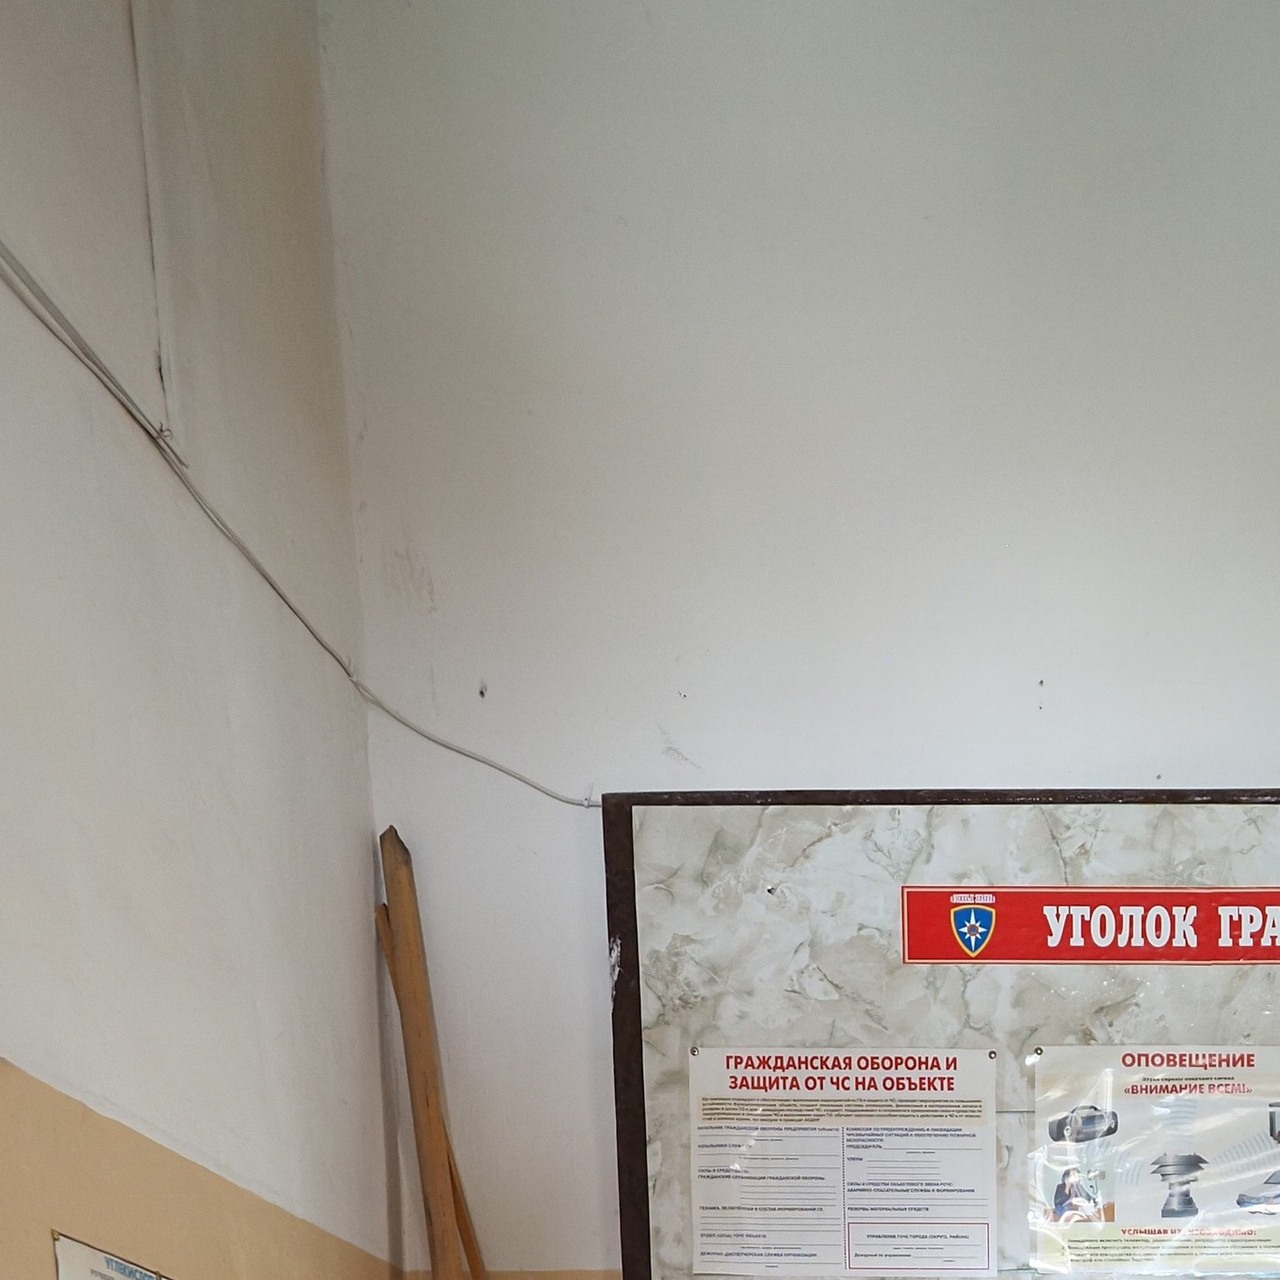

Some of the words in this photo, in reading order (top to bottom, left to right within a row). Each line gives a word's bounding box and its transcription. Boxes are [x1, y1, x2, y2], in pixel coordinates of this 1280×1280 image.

[1045, 904, 1197, 947] УГОЛОК
[725, 1055, 852, 1072] ГРАЖДАНСКАЯ
[857, 1056, 941, 1071] ОБОРОНА
[945, 1056, 957, 1071] И
[1121, 1053, 1255, 1070] ОПОВЕЩЕНИЕ
[729, 1076, 800, 1092] ЗАЩИТА
[804, 1077, 825, 1091] ОТ
[830, 1077, 850, 1091] ЧС
[854, 1077, 877, 1091] НА
[882, 1077, 955, 1091] ОБЪЕКТЕ
[1124, 1084, 1205, 1095] «ВНИМАНИЕ
[1208, 1083, 1253, 1094] ВСЕМ!»
